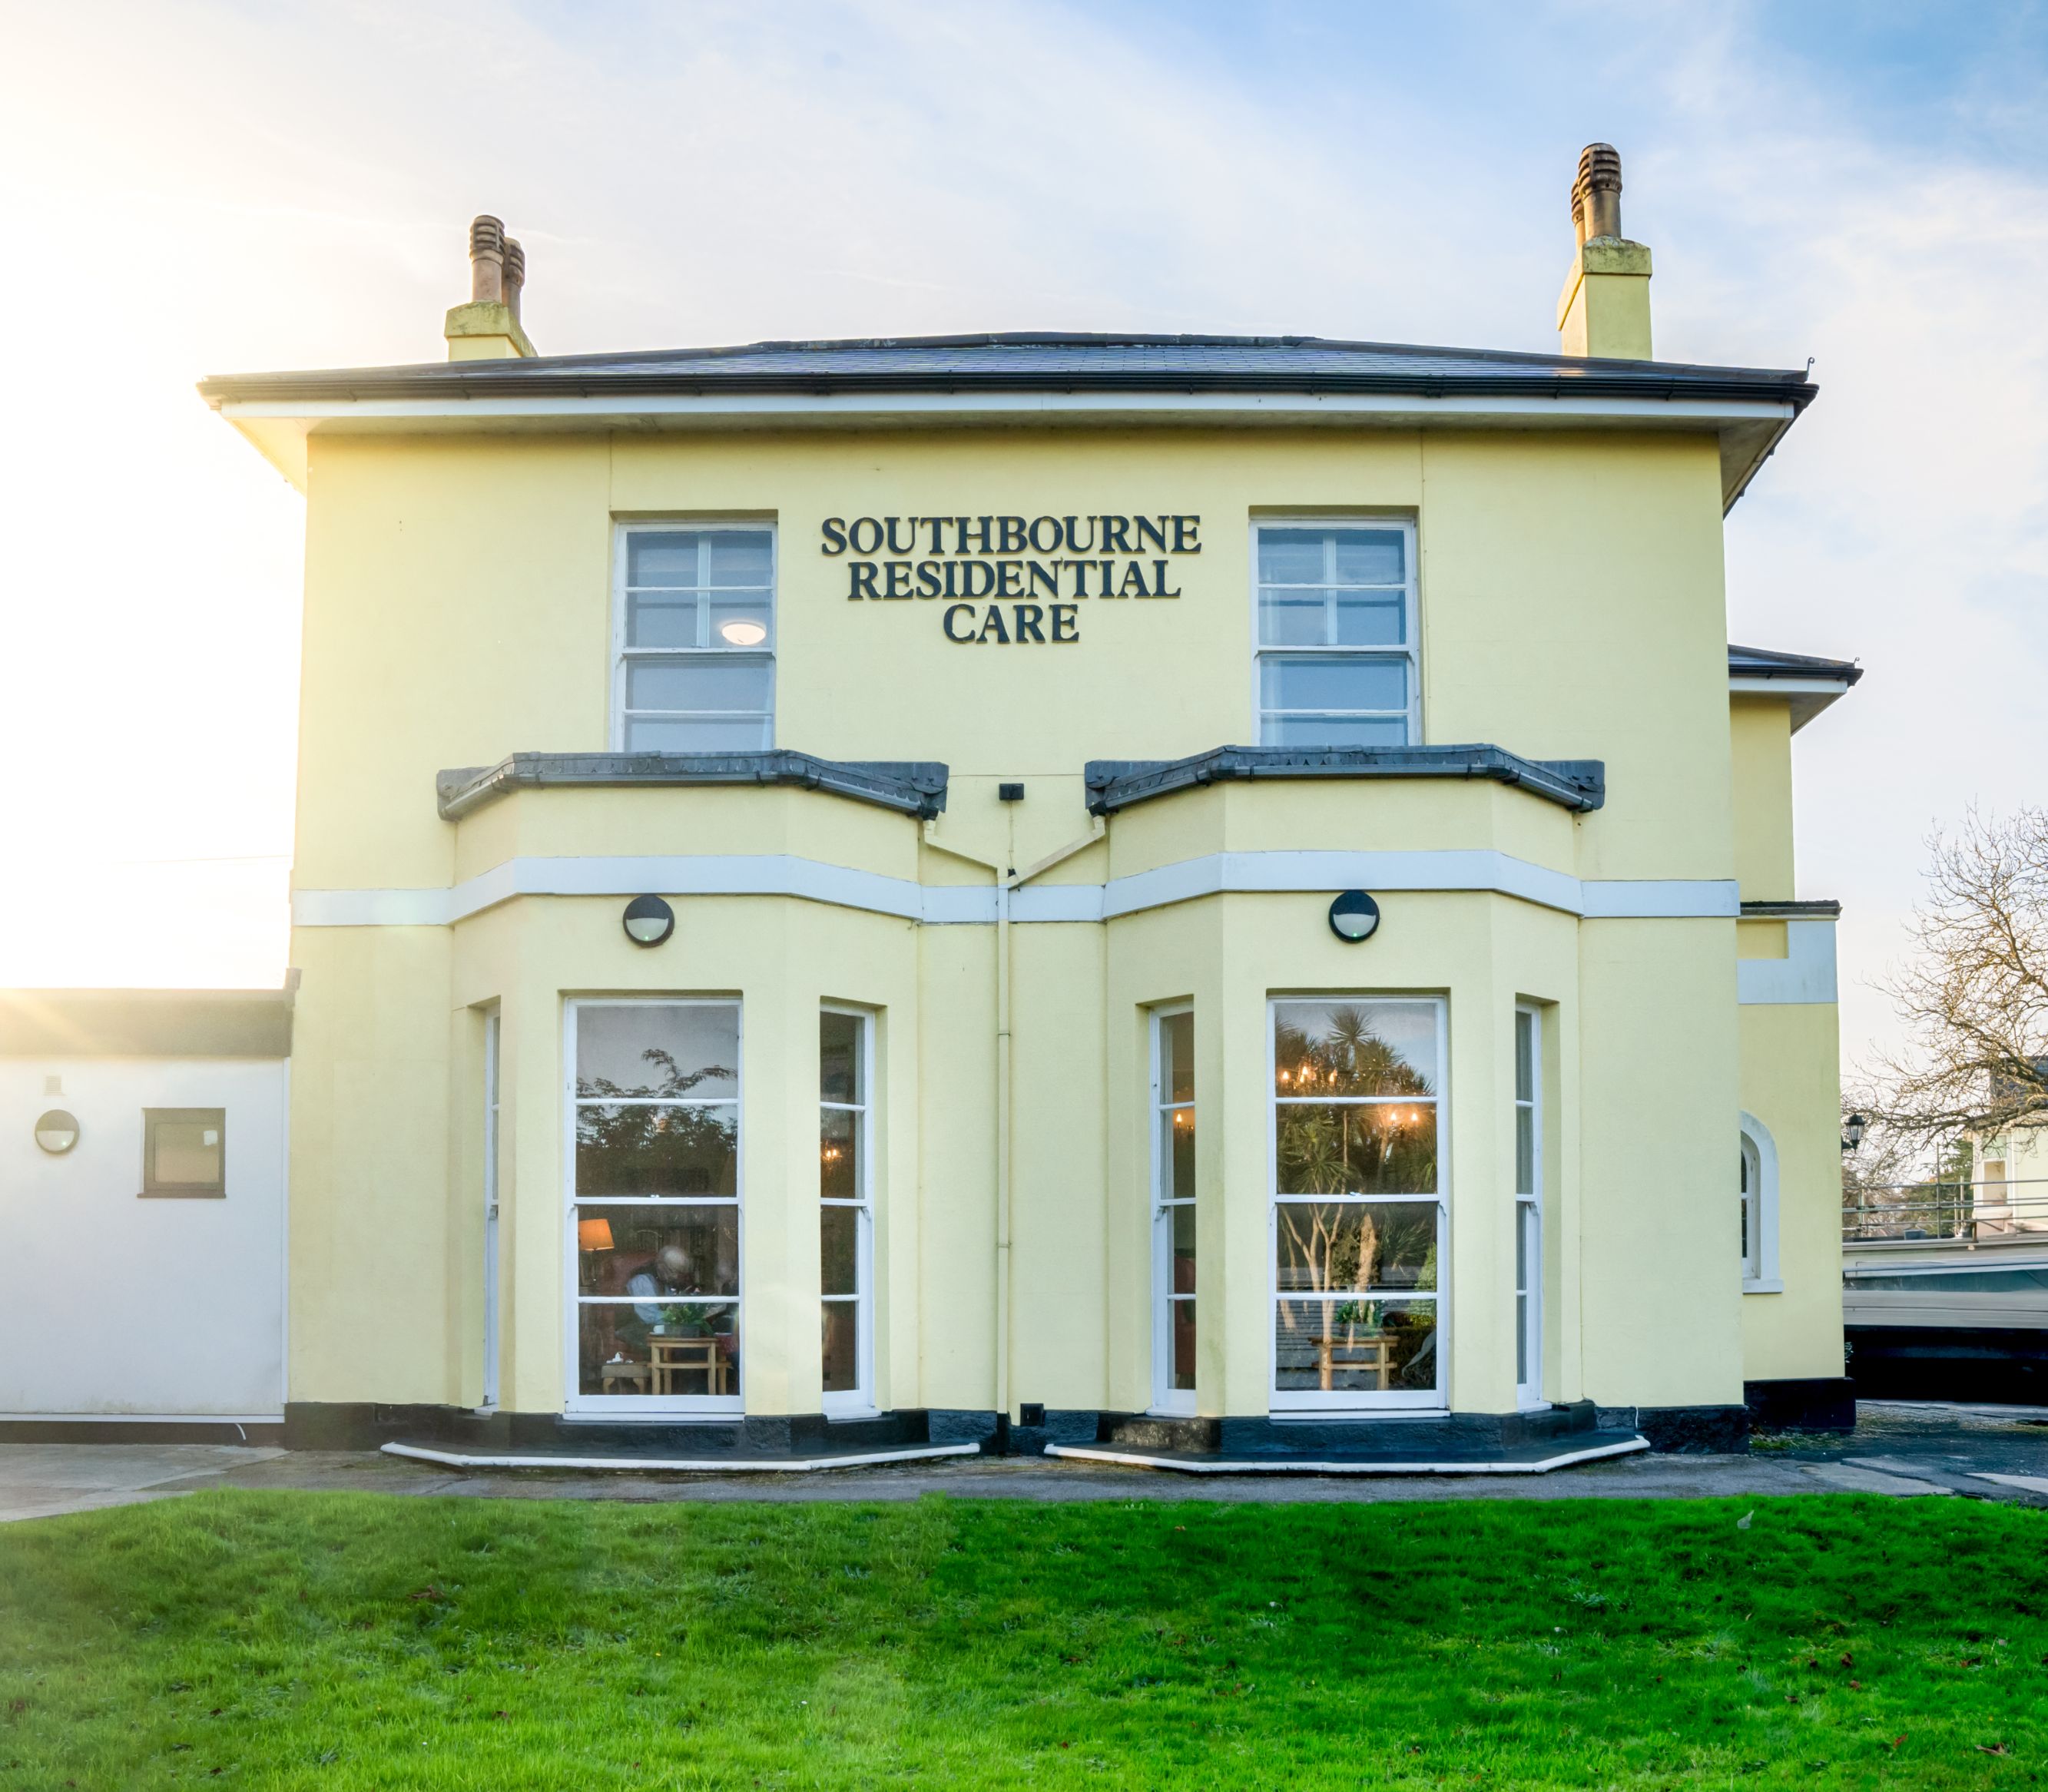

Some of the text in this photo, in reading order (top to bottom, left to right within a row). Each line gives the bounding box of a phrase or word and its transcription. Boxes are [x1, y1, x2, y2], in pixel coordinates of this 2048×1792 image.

[821, 515, 1202, 555] SOUTHBOURNE
[847, 559, 1181, 601] RESIDENTIAL
[943, 603, 1079, 644] CARE
